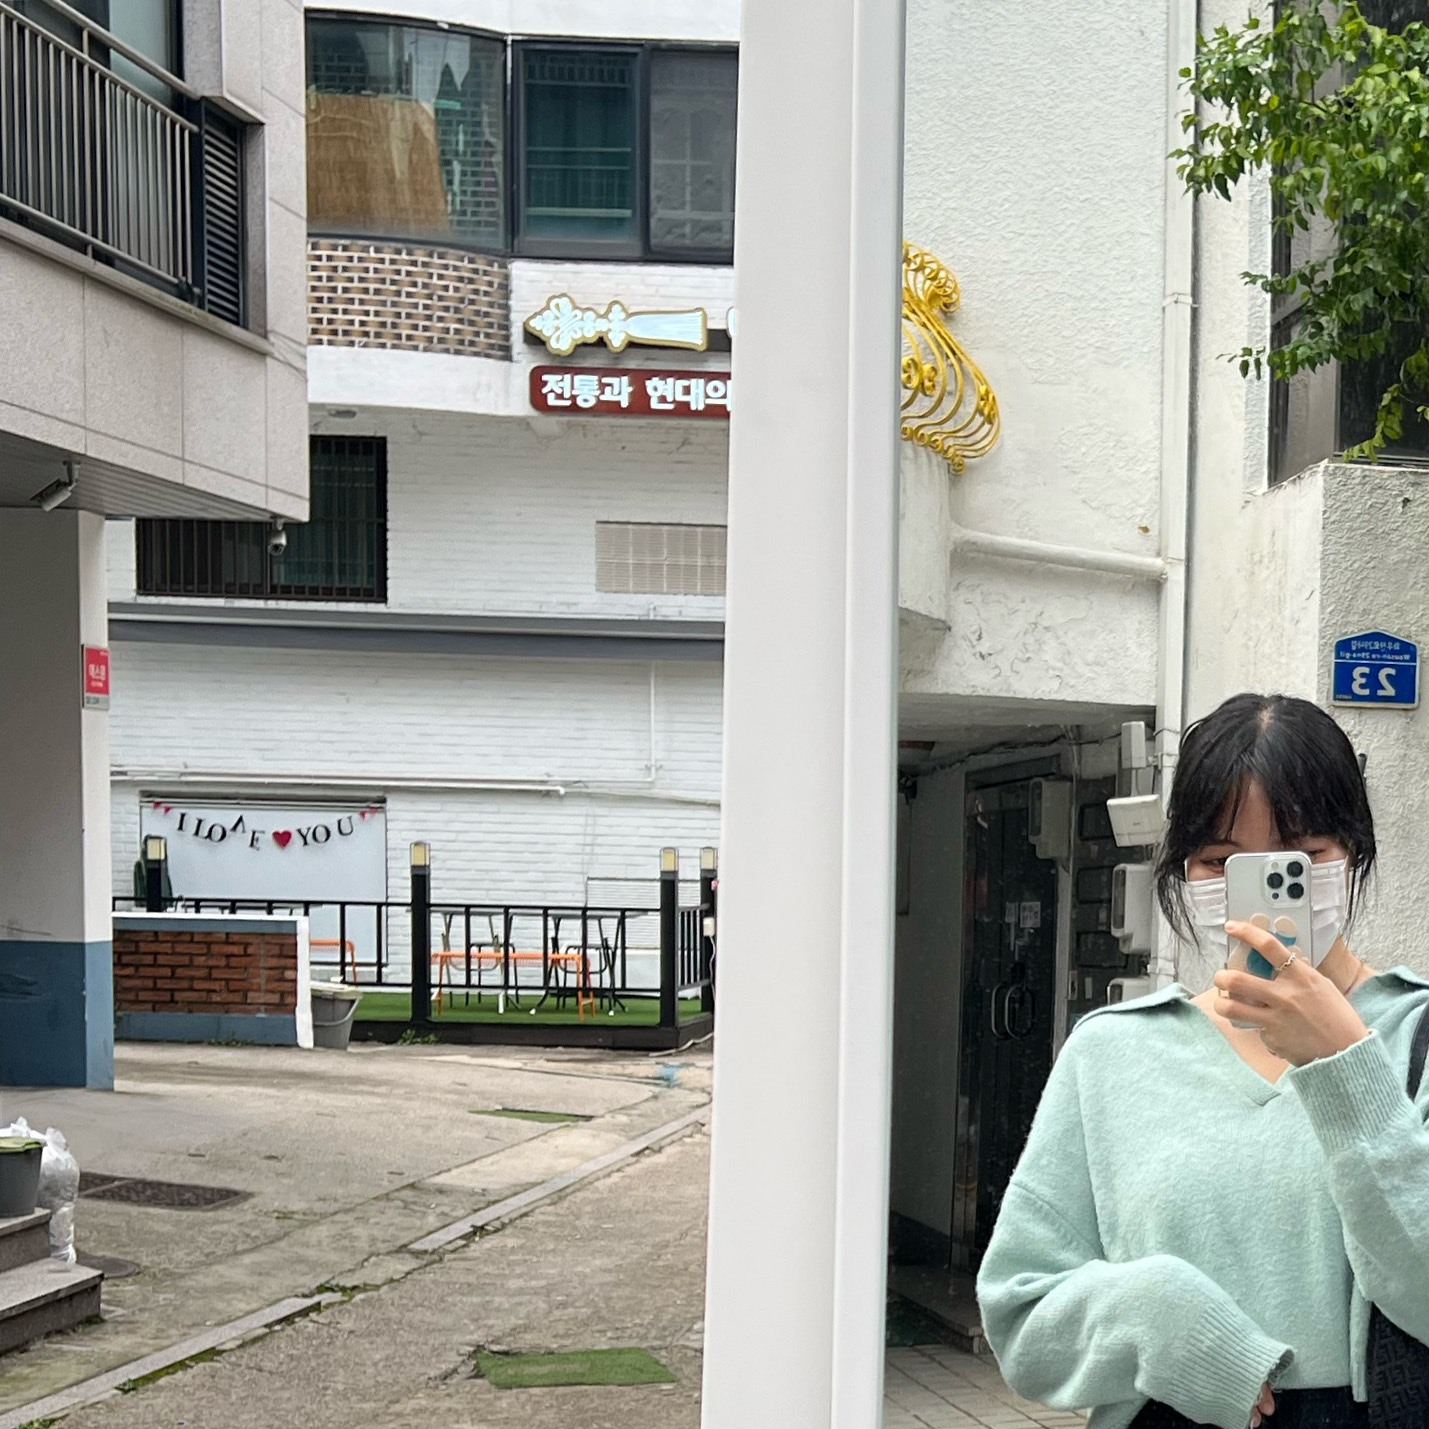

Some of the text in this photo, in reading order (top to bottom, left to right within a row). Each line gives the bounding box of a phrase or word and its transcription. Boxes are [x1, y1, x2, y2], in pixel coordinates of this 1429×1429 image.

[541, 373, 633, 408] 전통과
[176, 812, 187, 832] I
[296, 815, 355, 847] YOU
